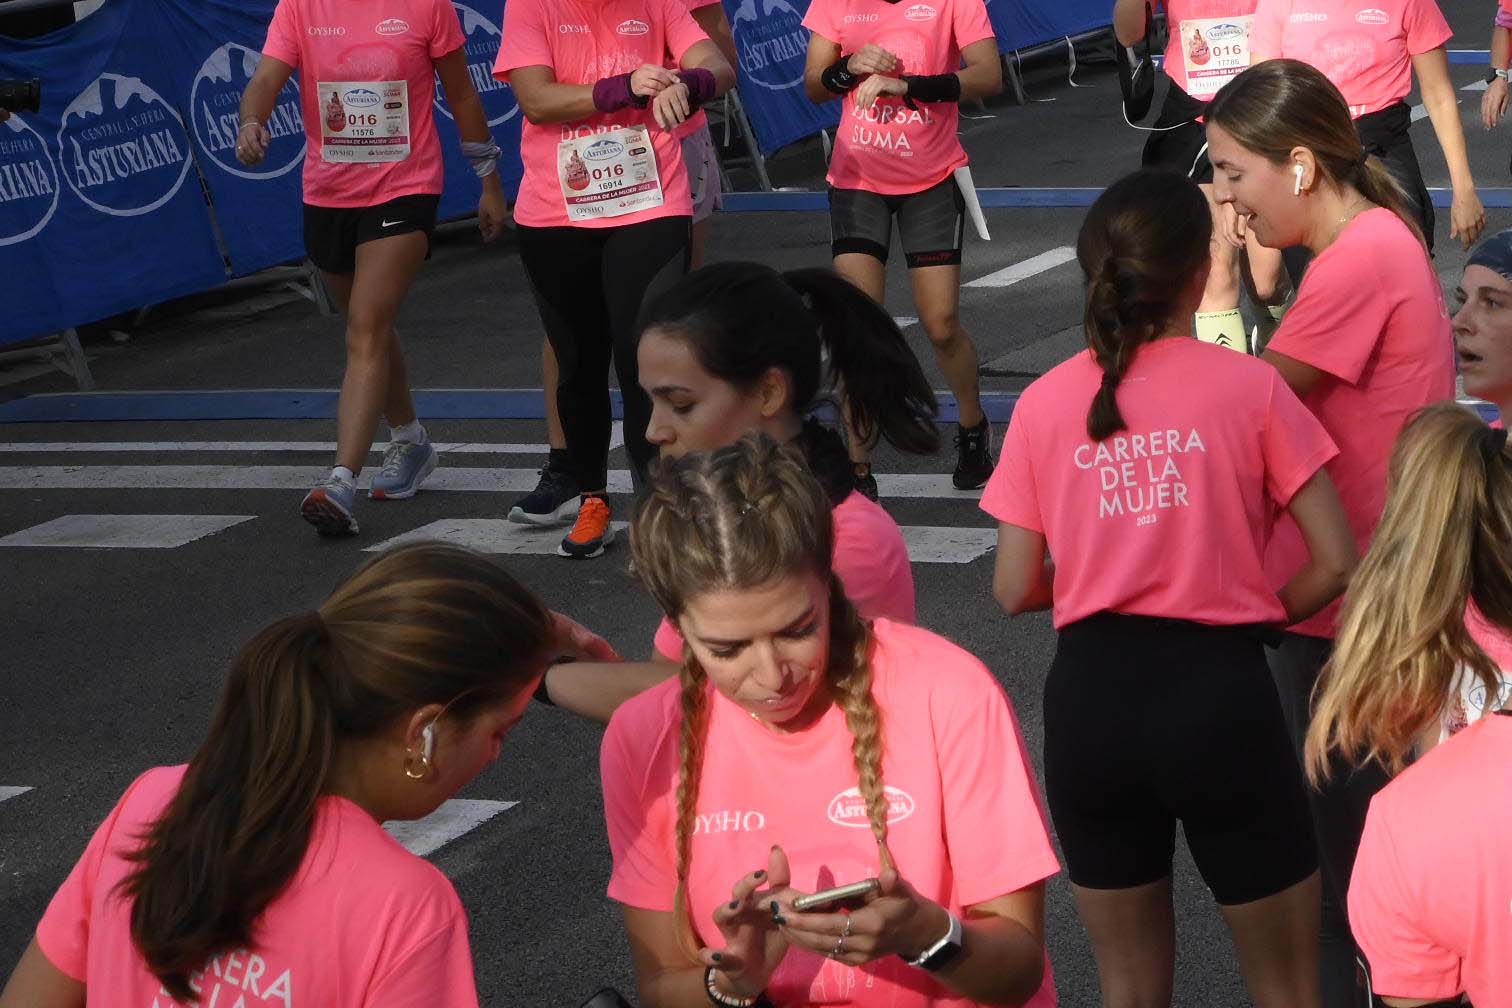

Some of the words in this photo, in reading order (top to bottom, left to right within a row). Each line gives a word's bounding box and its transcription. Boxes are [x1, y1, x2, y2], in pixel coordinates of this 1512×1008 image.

[843, 13, 879, 24] OYSHO
[308, 25, 346, 37] OYSHO
[1212, 44, 1241, 57] 016
[348, 114, 378, 126] 016
[351, 128, 375, 137] 11576
[852, 123, 911, 150] SUMA
[70, 128, 184, 190] ASTURIANA
[592, 164, 624, 180] 016
[599, 179, 623, 190] 16914
[1074, 428, 1207, 470] CARRERA
[1100, 463, 1138, 491] DE
[1147, 456, 1182, 484] LA
[1099, 482, 1190, 519] MUJER
[1136, 513, 1156, 527] 2023
